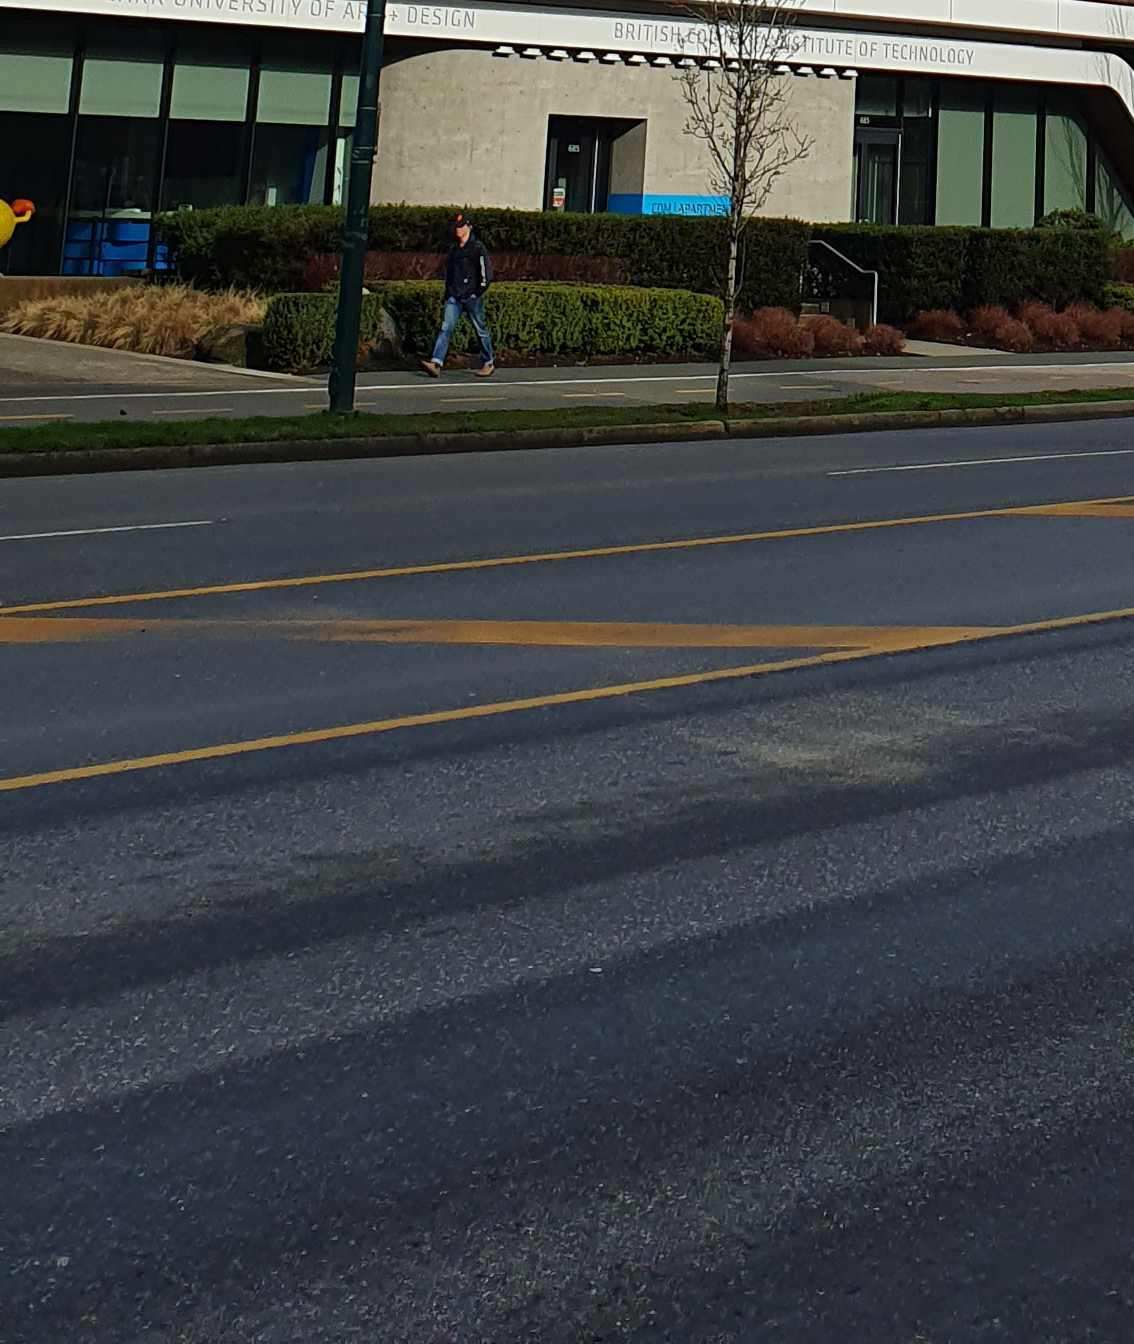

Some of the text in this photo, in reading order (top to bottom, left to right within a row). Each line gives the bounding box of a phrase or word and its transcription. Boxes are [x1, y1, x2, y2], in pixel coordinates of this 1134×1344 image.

[342, 1, 367, 21] AR
[407, 6, 475, 29] DESIGN
[614, 22, 681, 44] BRITISH
[859, 40, 878, 58] OF
[883, 42, 974, 66] TECHNOLOGY
[678, 203, 733, 217] APARTMEN
